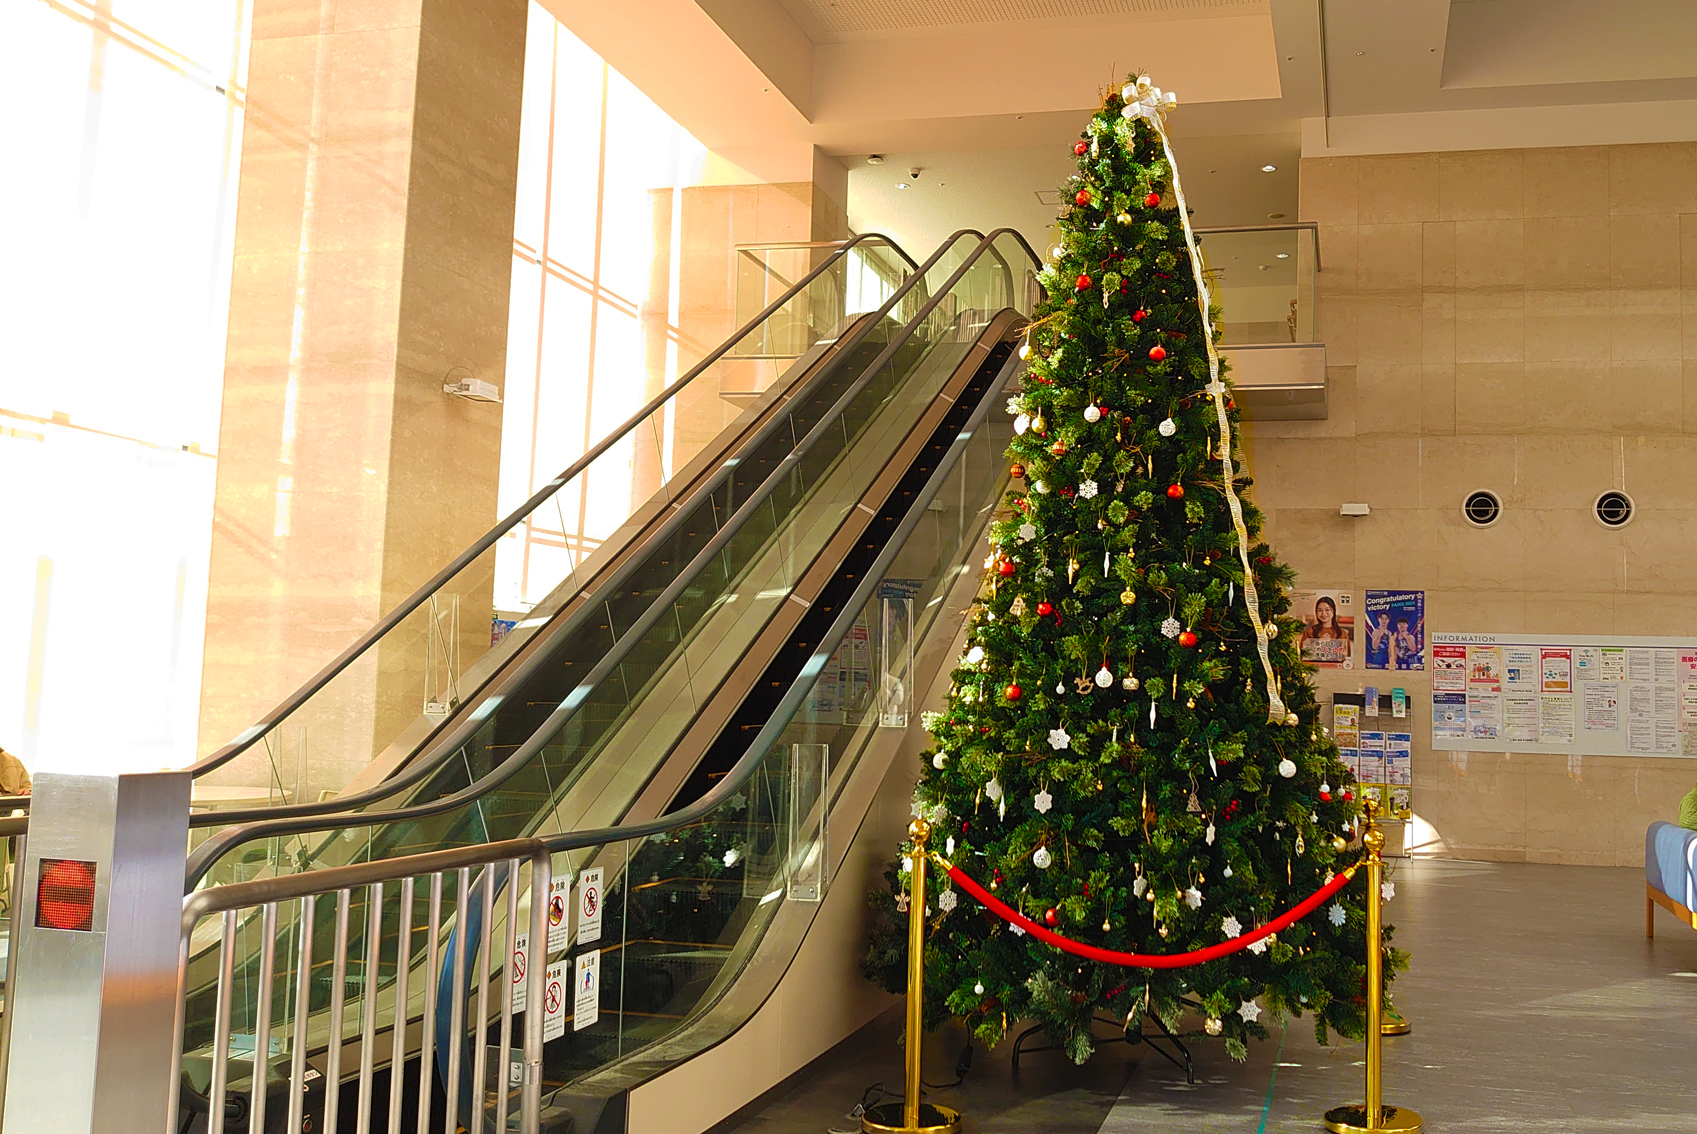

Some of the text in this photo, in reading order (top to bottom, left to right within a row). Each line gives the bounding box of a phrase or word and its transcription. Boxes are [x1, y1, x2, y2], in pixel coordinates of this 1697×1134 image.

[1366, 594, 1415, 604] Congratulatory
[1367, 603, 1390, 611] victory
[590, 873, 599, 883] 危険
[554, 881, 565, 892] 危険
[517, 939, 526, 949] 危険
[586, 956, 595, 967] 注意
[552, 968, 561, 979] 危険
